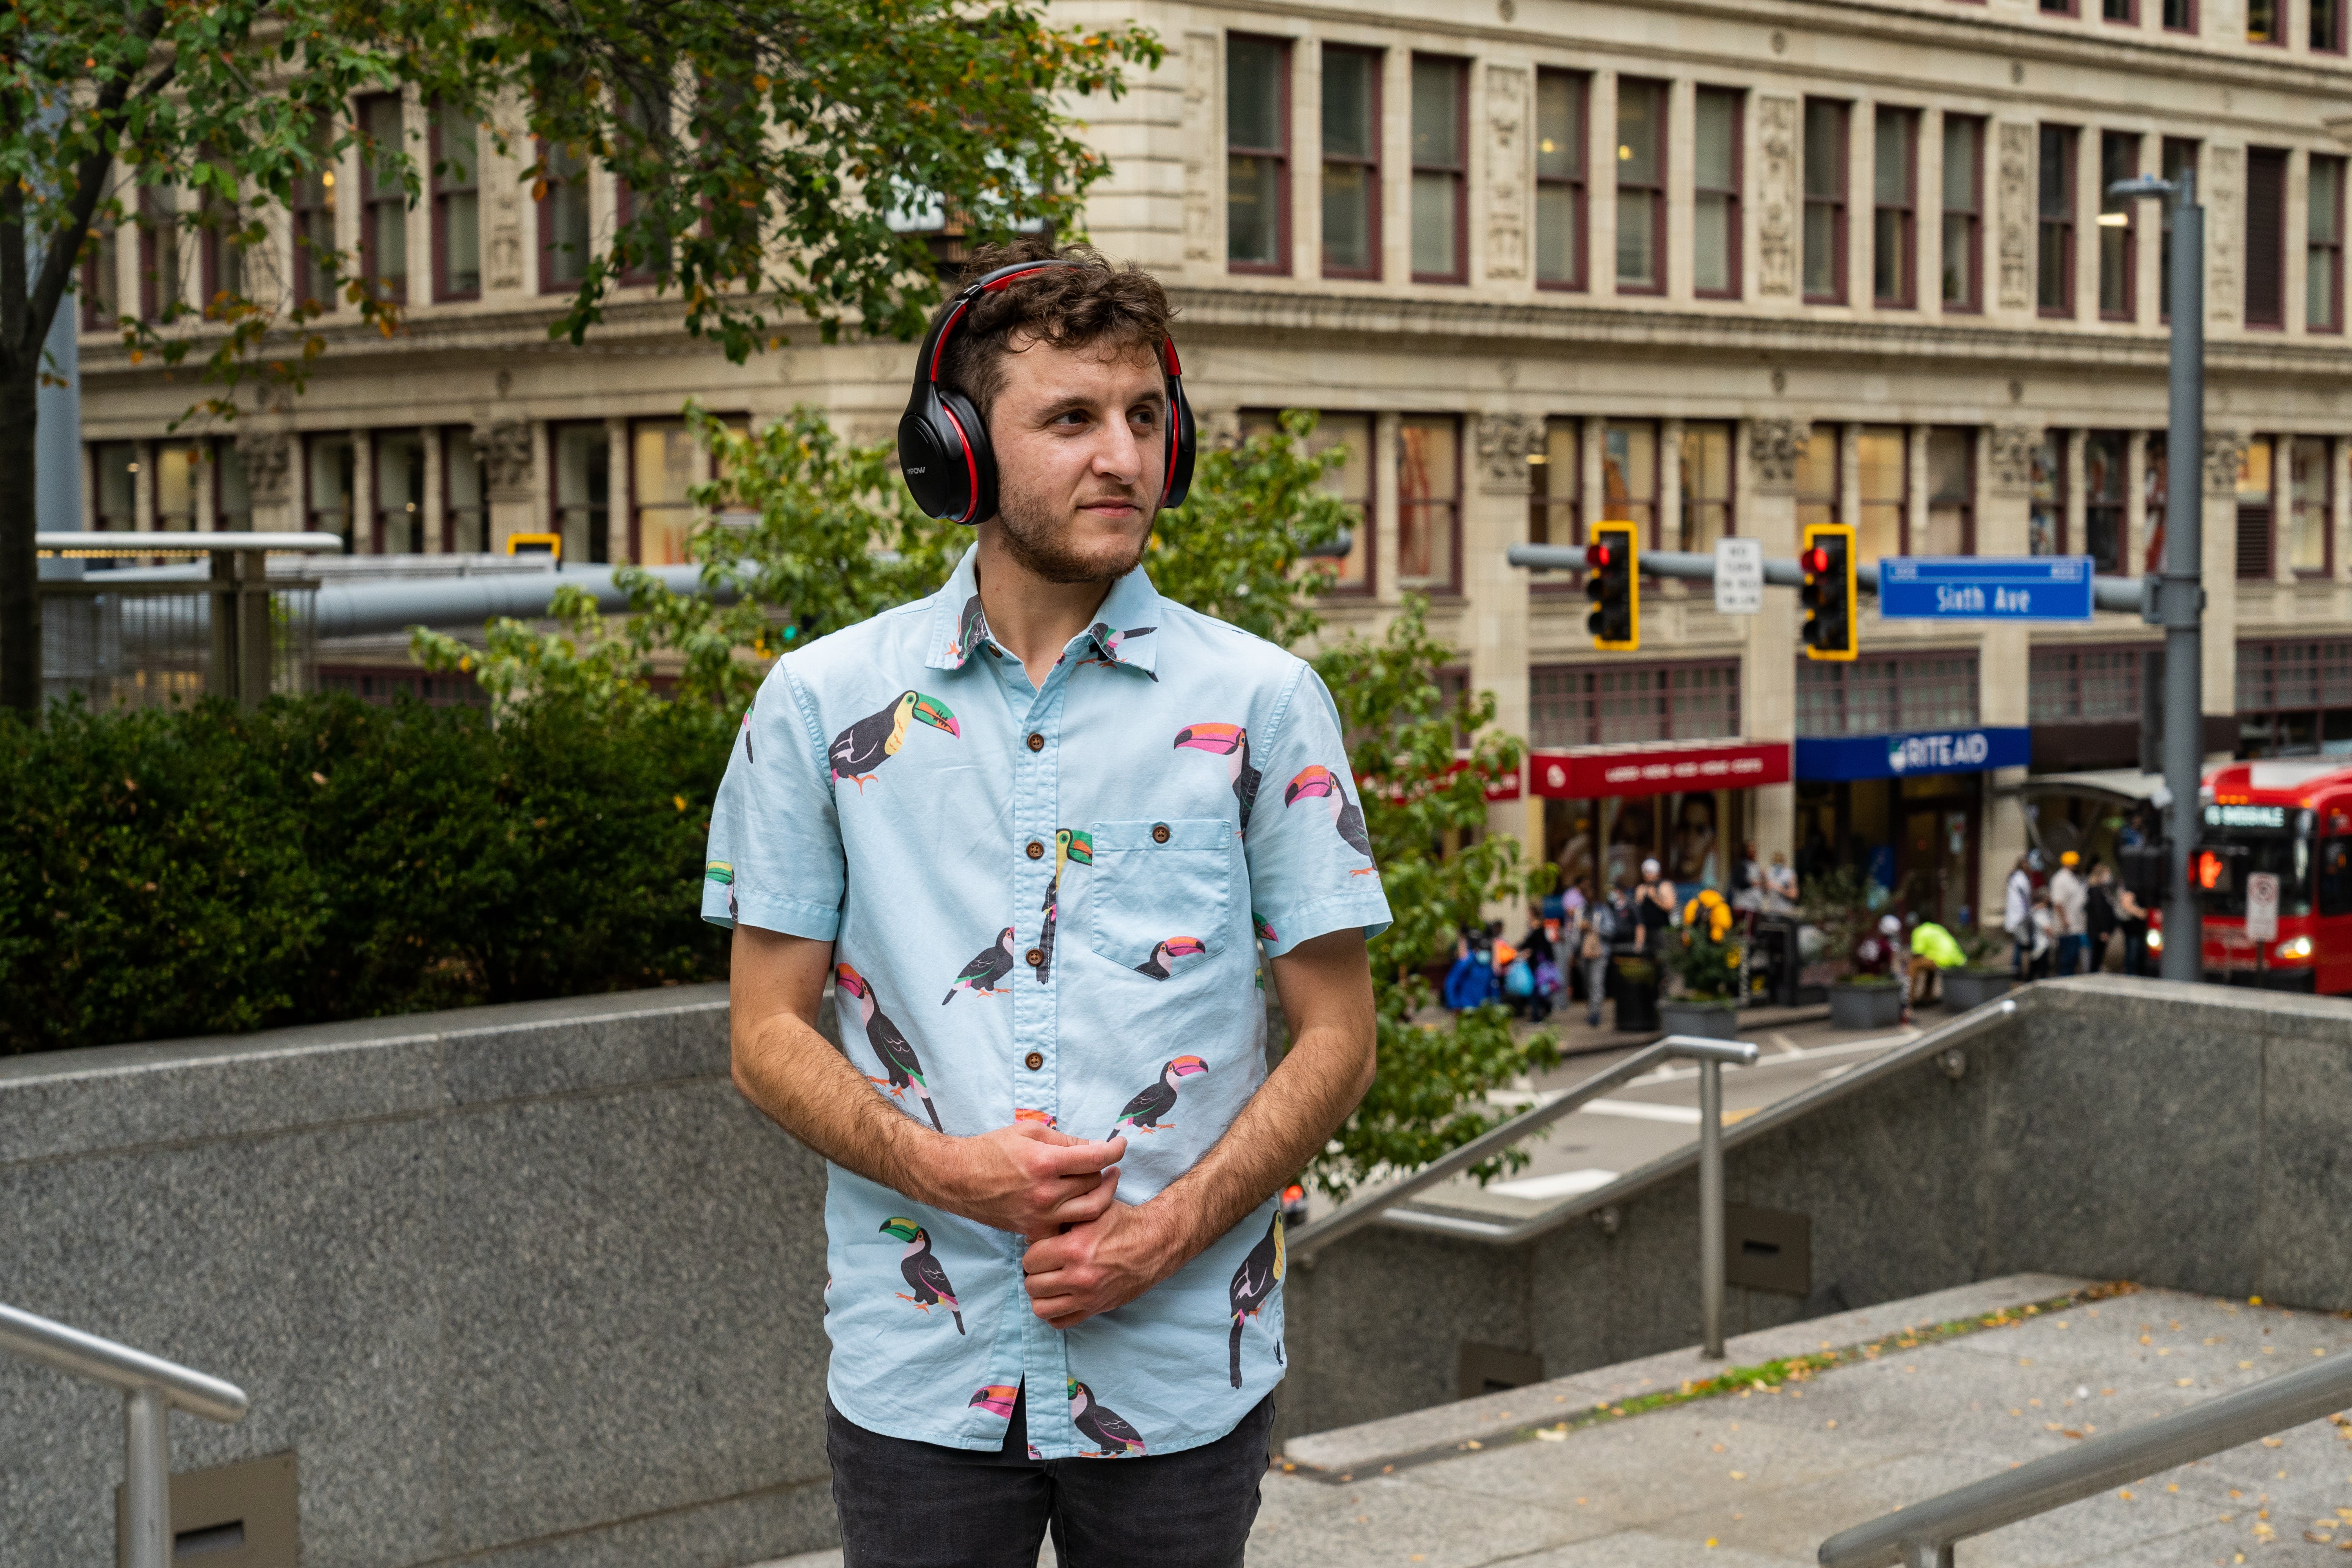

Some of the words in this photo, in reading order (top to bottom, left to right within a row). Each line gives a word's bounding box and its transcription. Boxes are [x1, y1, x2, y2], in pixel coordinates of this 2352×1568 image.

[907, 466, 926, 475] MPOW
[1936, 583, 1985, 612] Sixth
[1994, 586, 2031, 612] Ave
[1906, 735, 1953, 768] RITE
[1953, 732, 1989, 764] AID
